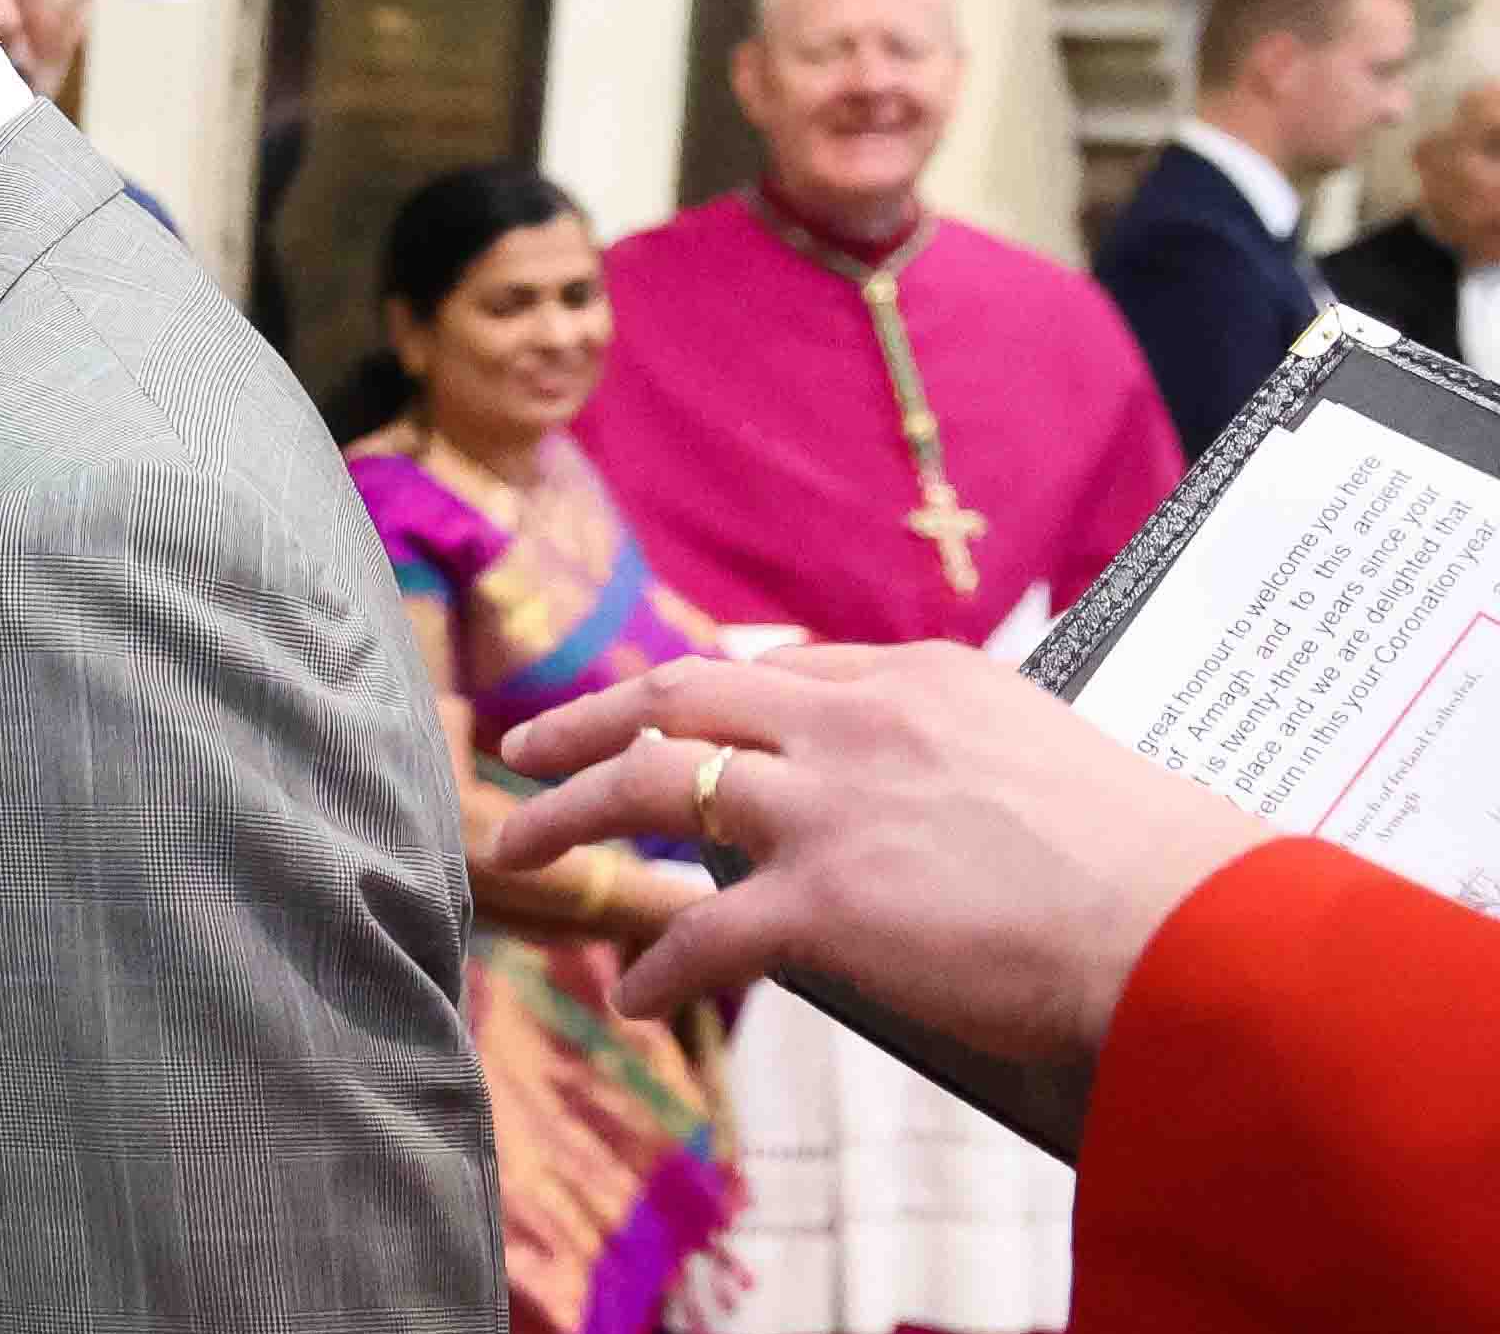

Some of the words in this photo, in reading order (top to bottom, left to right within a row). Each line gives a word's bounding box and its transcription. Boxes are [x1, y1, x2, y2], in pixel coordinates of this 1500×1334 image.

[1457, 519, 1496, 565] year
[1136, 704, 1185, 757] great
[1171, 637, 1235, 706] honour
[1225, 618, 1253, 640] to
[1245, 532, 1320, 618] welcome
[1311, 496, 1348, 535] you
[1337, 456, 1381, 497] here
[1165, 746, 1189, 771] of
[1187, 669, 1255, 743] Armagh
[1255, 618, 1292, 660] and
[1288, 590, 1316, 612] to
[1312, 544, 1352, 580] this
[1353, 469, 1412, 536] ancient
[1205, 755, 1227, 775] is
[1219, 639, 1320, 753] twenty-three
[1314, 581, 1365, 639] years
[1359, 528, 1407, 579] since
[1401, 484, 1440, 529] your
[1234, 740, 1283, 795] place
[1278, 696, 1316, 737] and
[1309, 666, 1341, 695] we
[1337, 629, 1371, 663] are
[1366, 536, 1442, 624] delighted
[1432, 499, 1473, 536] that
[1373, 562, 1466, 664] Coronation
[1309, 710, 1350, 746] this
[1341, 663, 1383, 714] your
[1299, 746, 1322, 766] in
